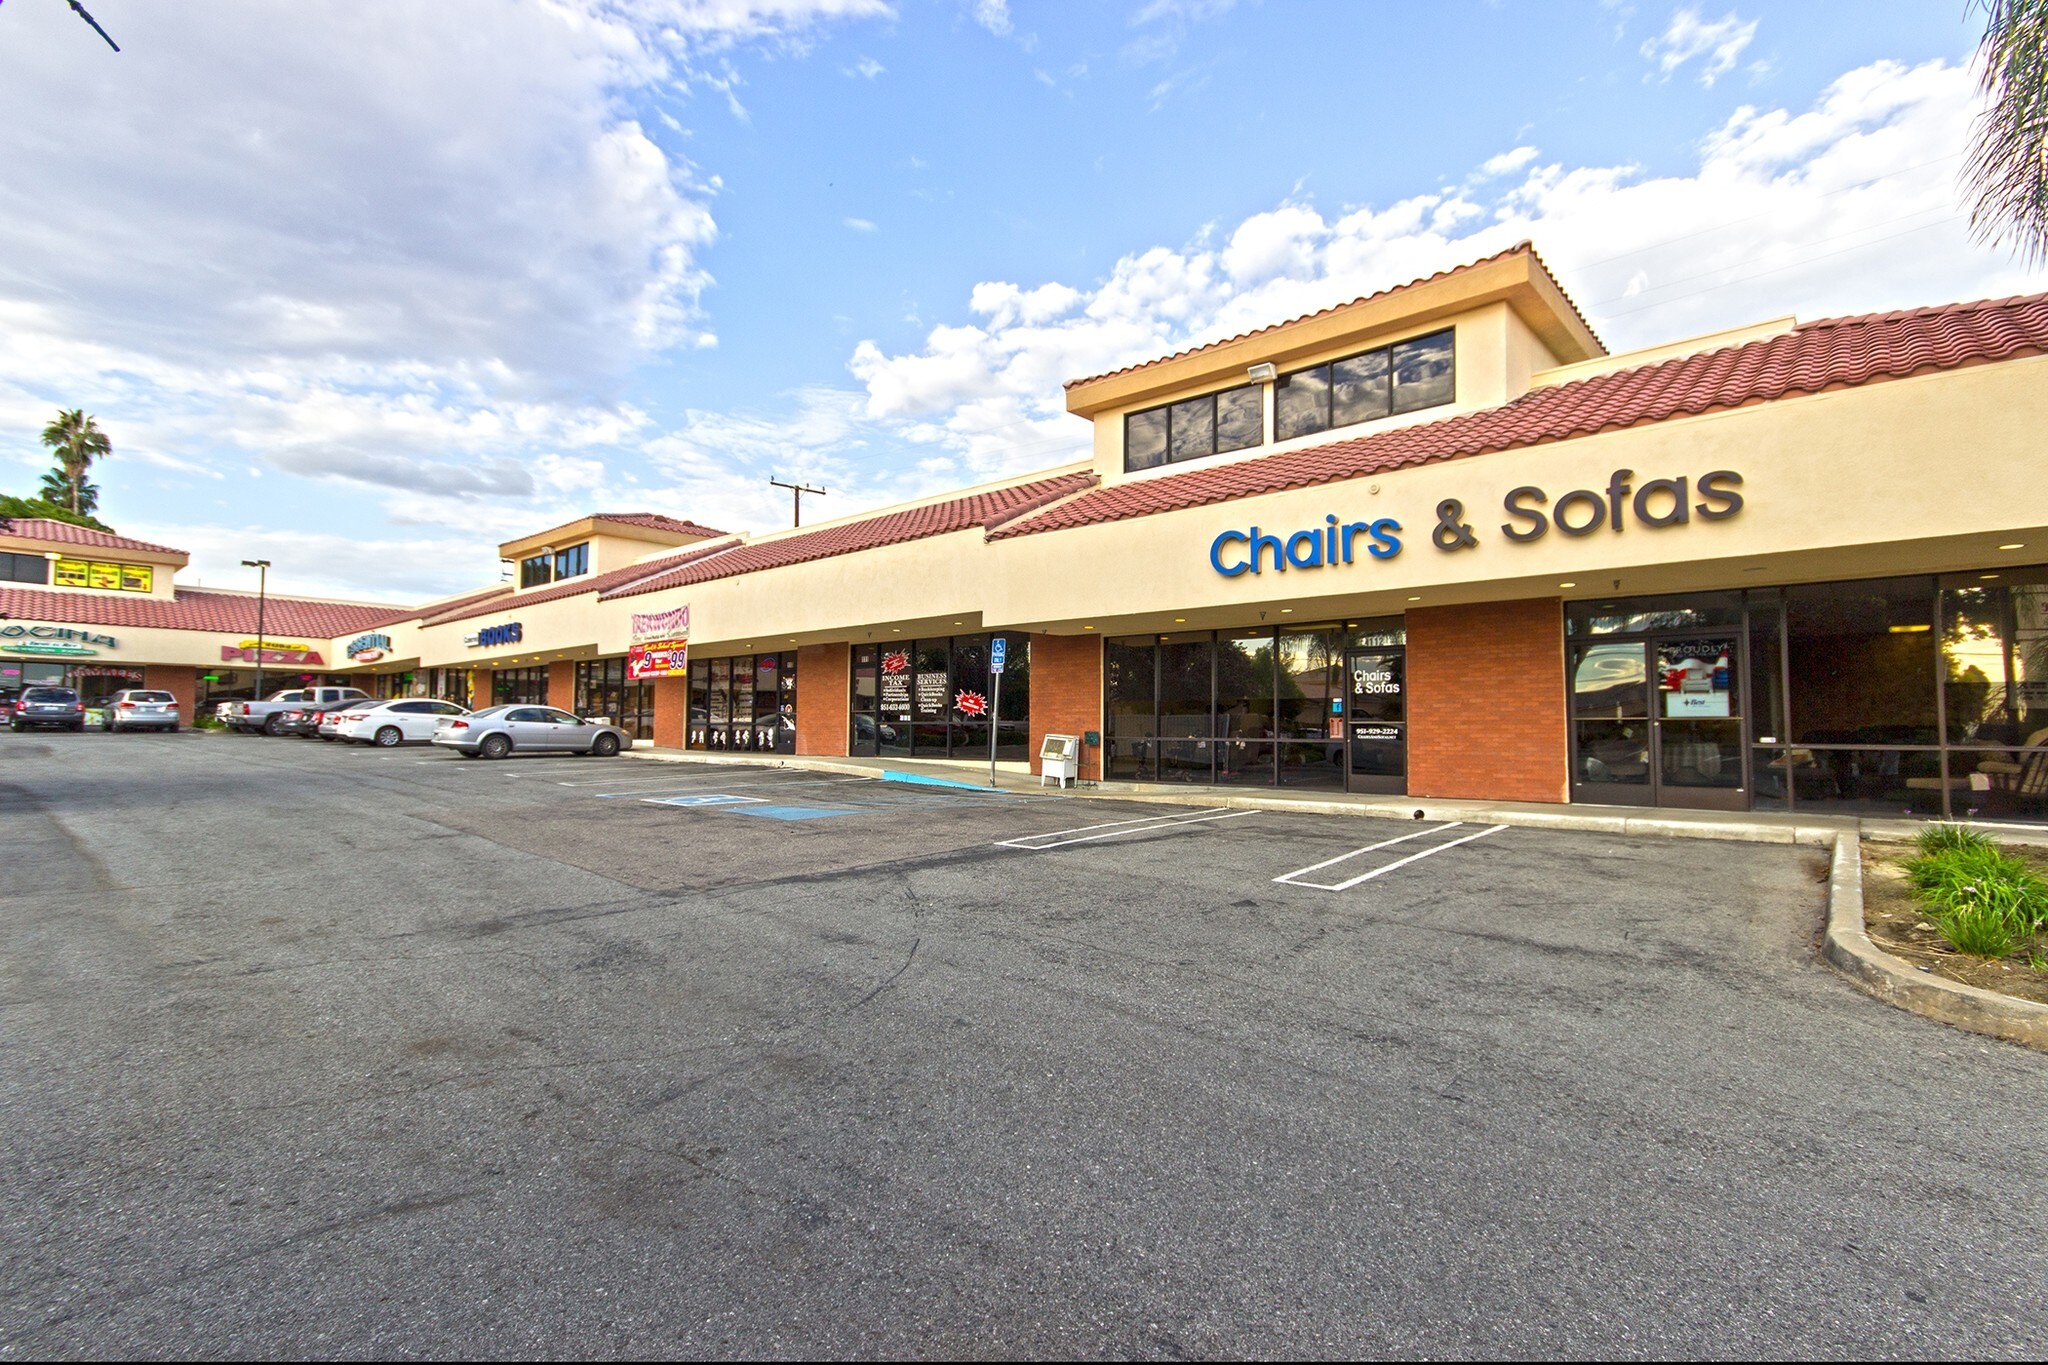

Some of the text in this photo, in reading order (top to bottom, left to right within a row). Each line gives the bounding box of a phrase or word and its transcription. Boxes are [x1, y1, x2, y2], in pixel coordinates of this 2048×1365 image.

[1210, 469, 1744, 577] Chairs & Sofas
[480, 622, 522, 646] BOOKS
[221, 646, 325, 666] PIZZA
[644, 651, 652, 667] 9
[1354, 670, 1391, 682] Chairs
[1355, 682, 1400, 694] & Sofas
